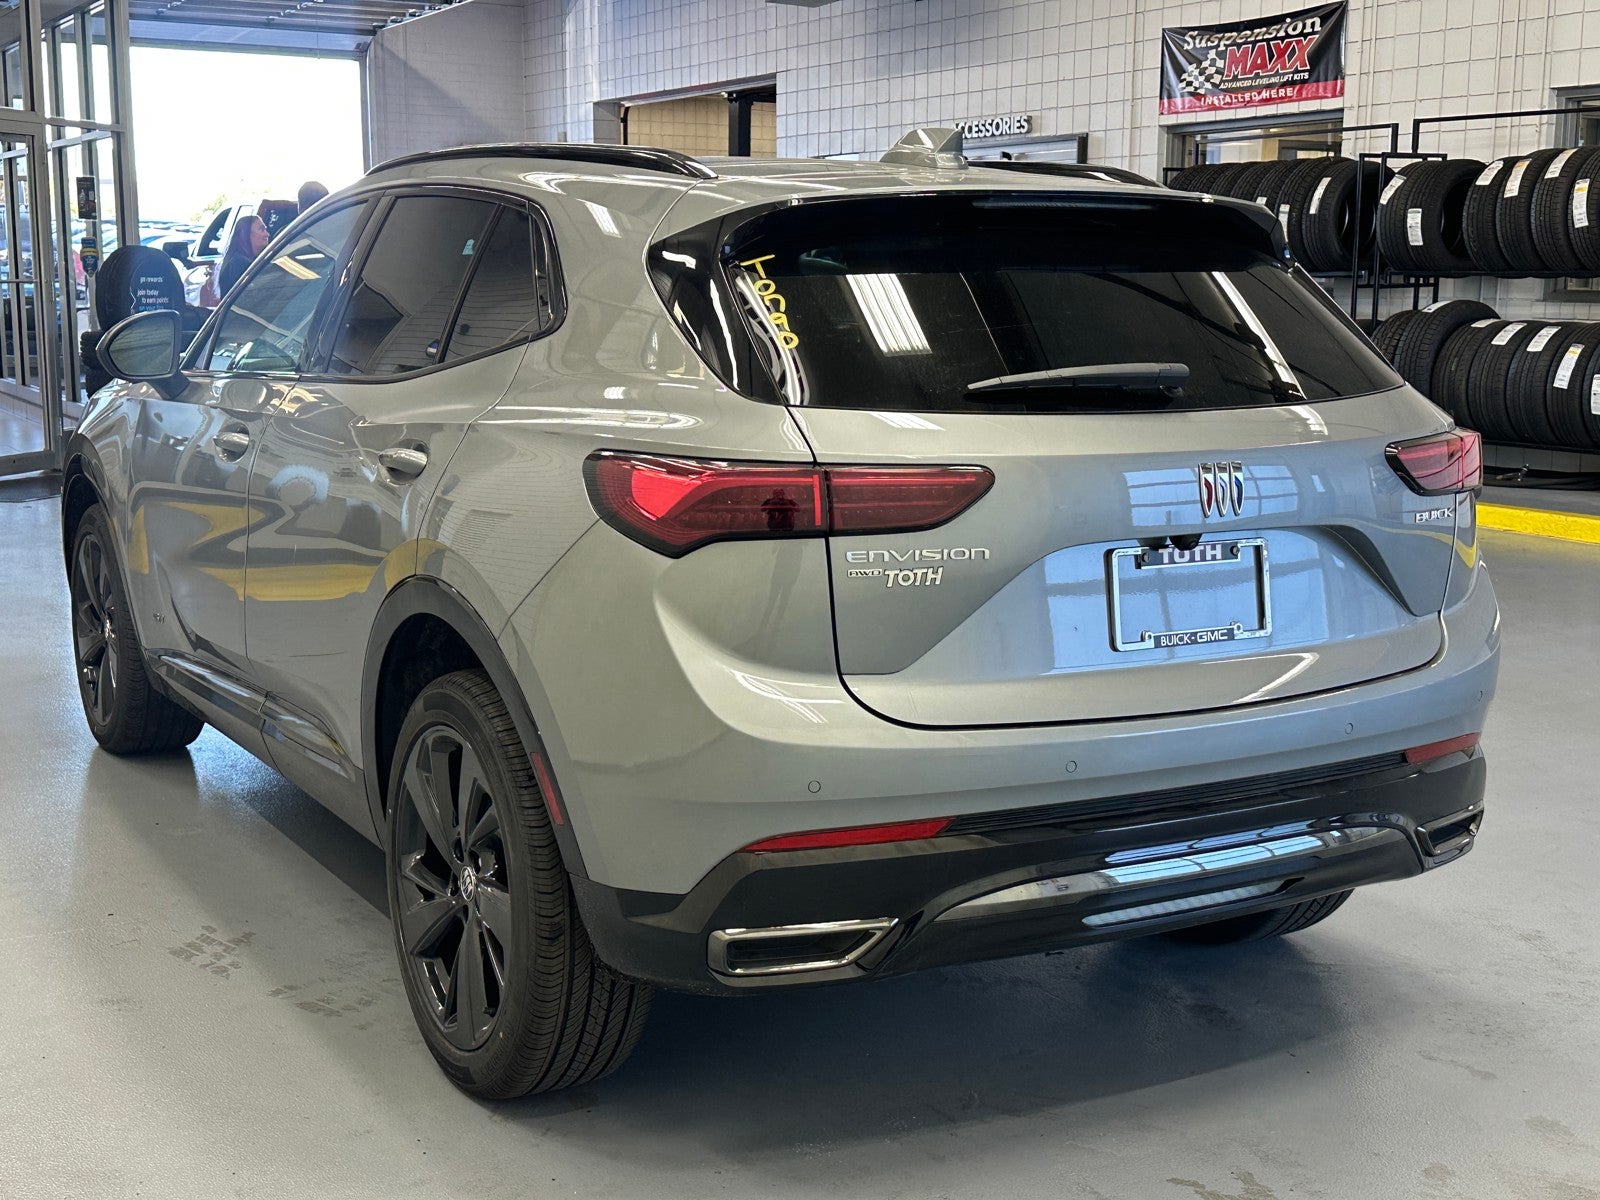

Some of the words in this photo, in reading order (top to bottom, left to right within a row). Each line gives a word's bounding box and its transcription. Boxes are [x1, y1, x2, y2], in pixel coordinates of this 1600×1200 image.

[1183, 15, 1322, 50] Suspension
[1222, 35, 1319, 80] MAXX
[1219, 79, 1251, 89] ADVANCED
[1251, 76, 1280, 86] LEVELING
[1280, 74, 1293, 82] LIFT
[1293, 72, 1309, 80] KITS
[1201, 91, 1260, 106] INSTALLED
[1262, 88, 1294, 99] HERE
[137, 289, 146, 297] join
[147, 289, 159, 297] today
[1415, 507, 1453, 523] BUICK
[846, 548, 990, 562] ENVISION
[1158, 544, 1222, 564] TOTH
[848, 569, 882, 577] AWD
[884, 566, 944, 588] TOTH
